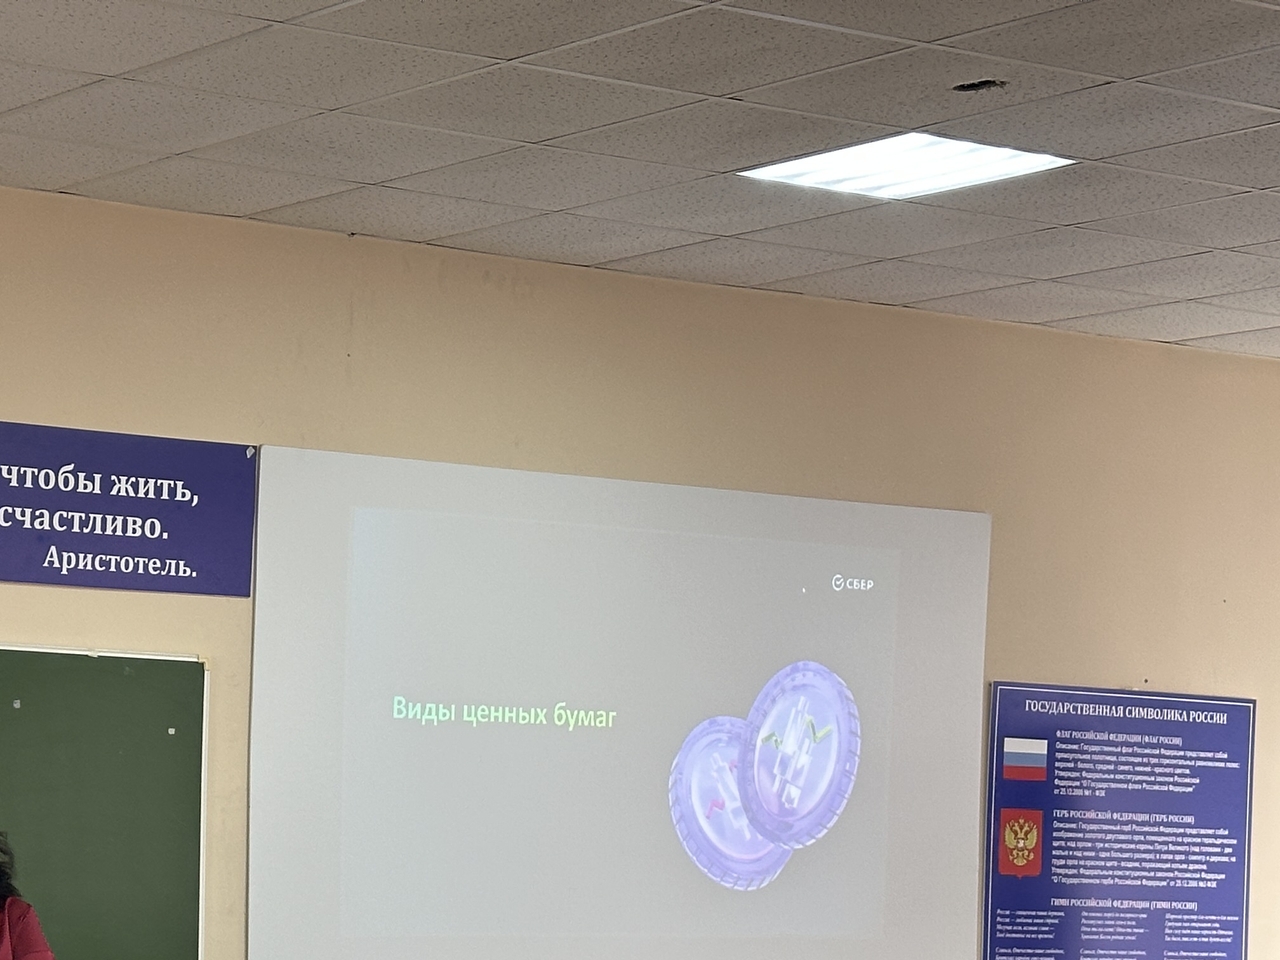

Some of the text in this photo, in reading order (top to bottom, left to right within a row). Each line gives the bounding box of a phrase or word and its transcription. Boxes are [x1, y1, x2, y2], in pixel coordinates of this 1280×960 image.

[0, 464, 101, 493] чтобы
[110, 476, 198, 506] жить,
[43, 546, 196, 577] Аристотель.
[846, 578, 874, 590] СБЕР
[393, 696, 617, 731] Виды ценных бумаг
[1025, 700, 1228, 725] ГОСУДАРСТВЕННАЯ СИМВОЛИКА РОССИИ
